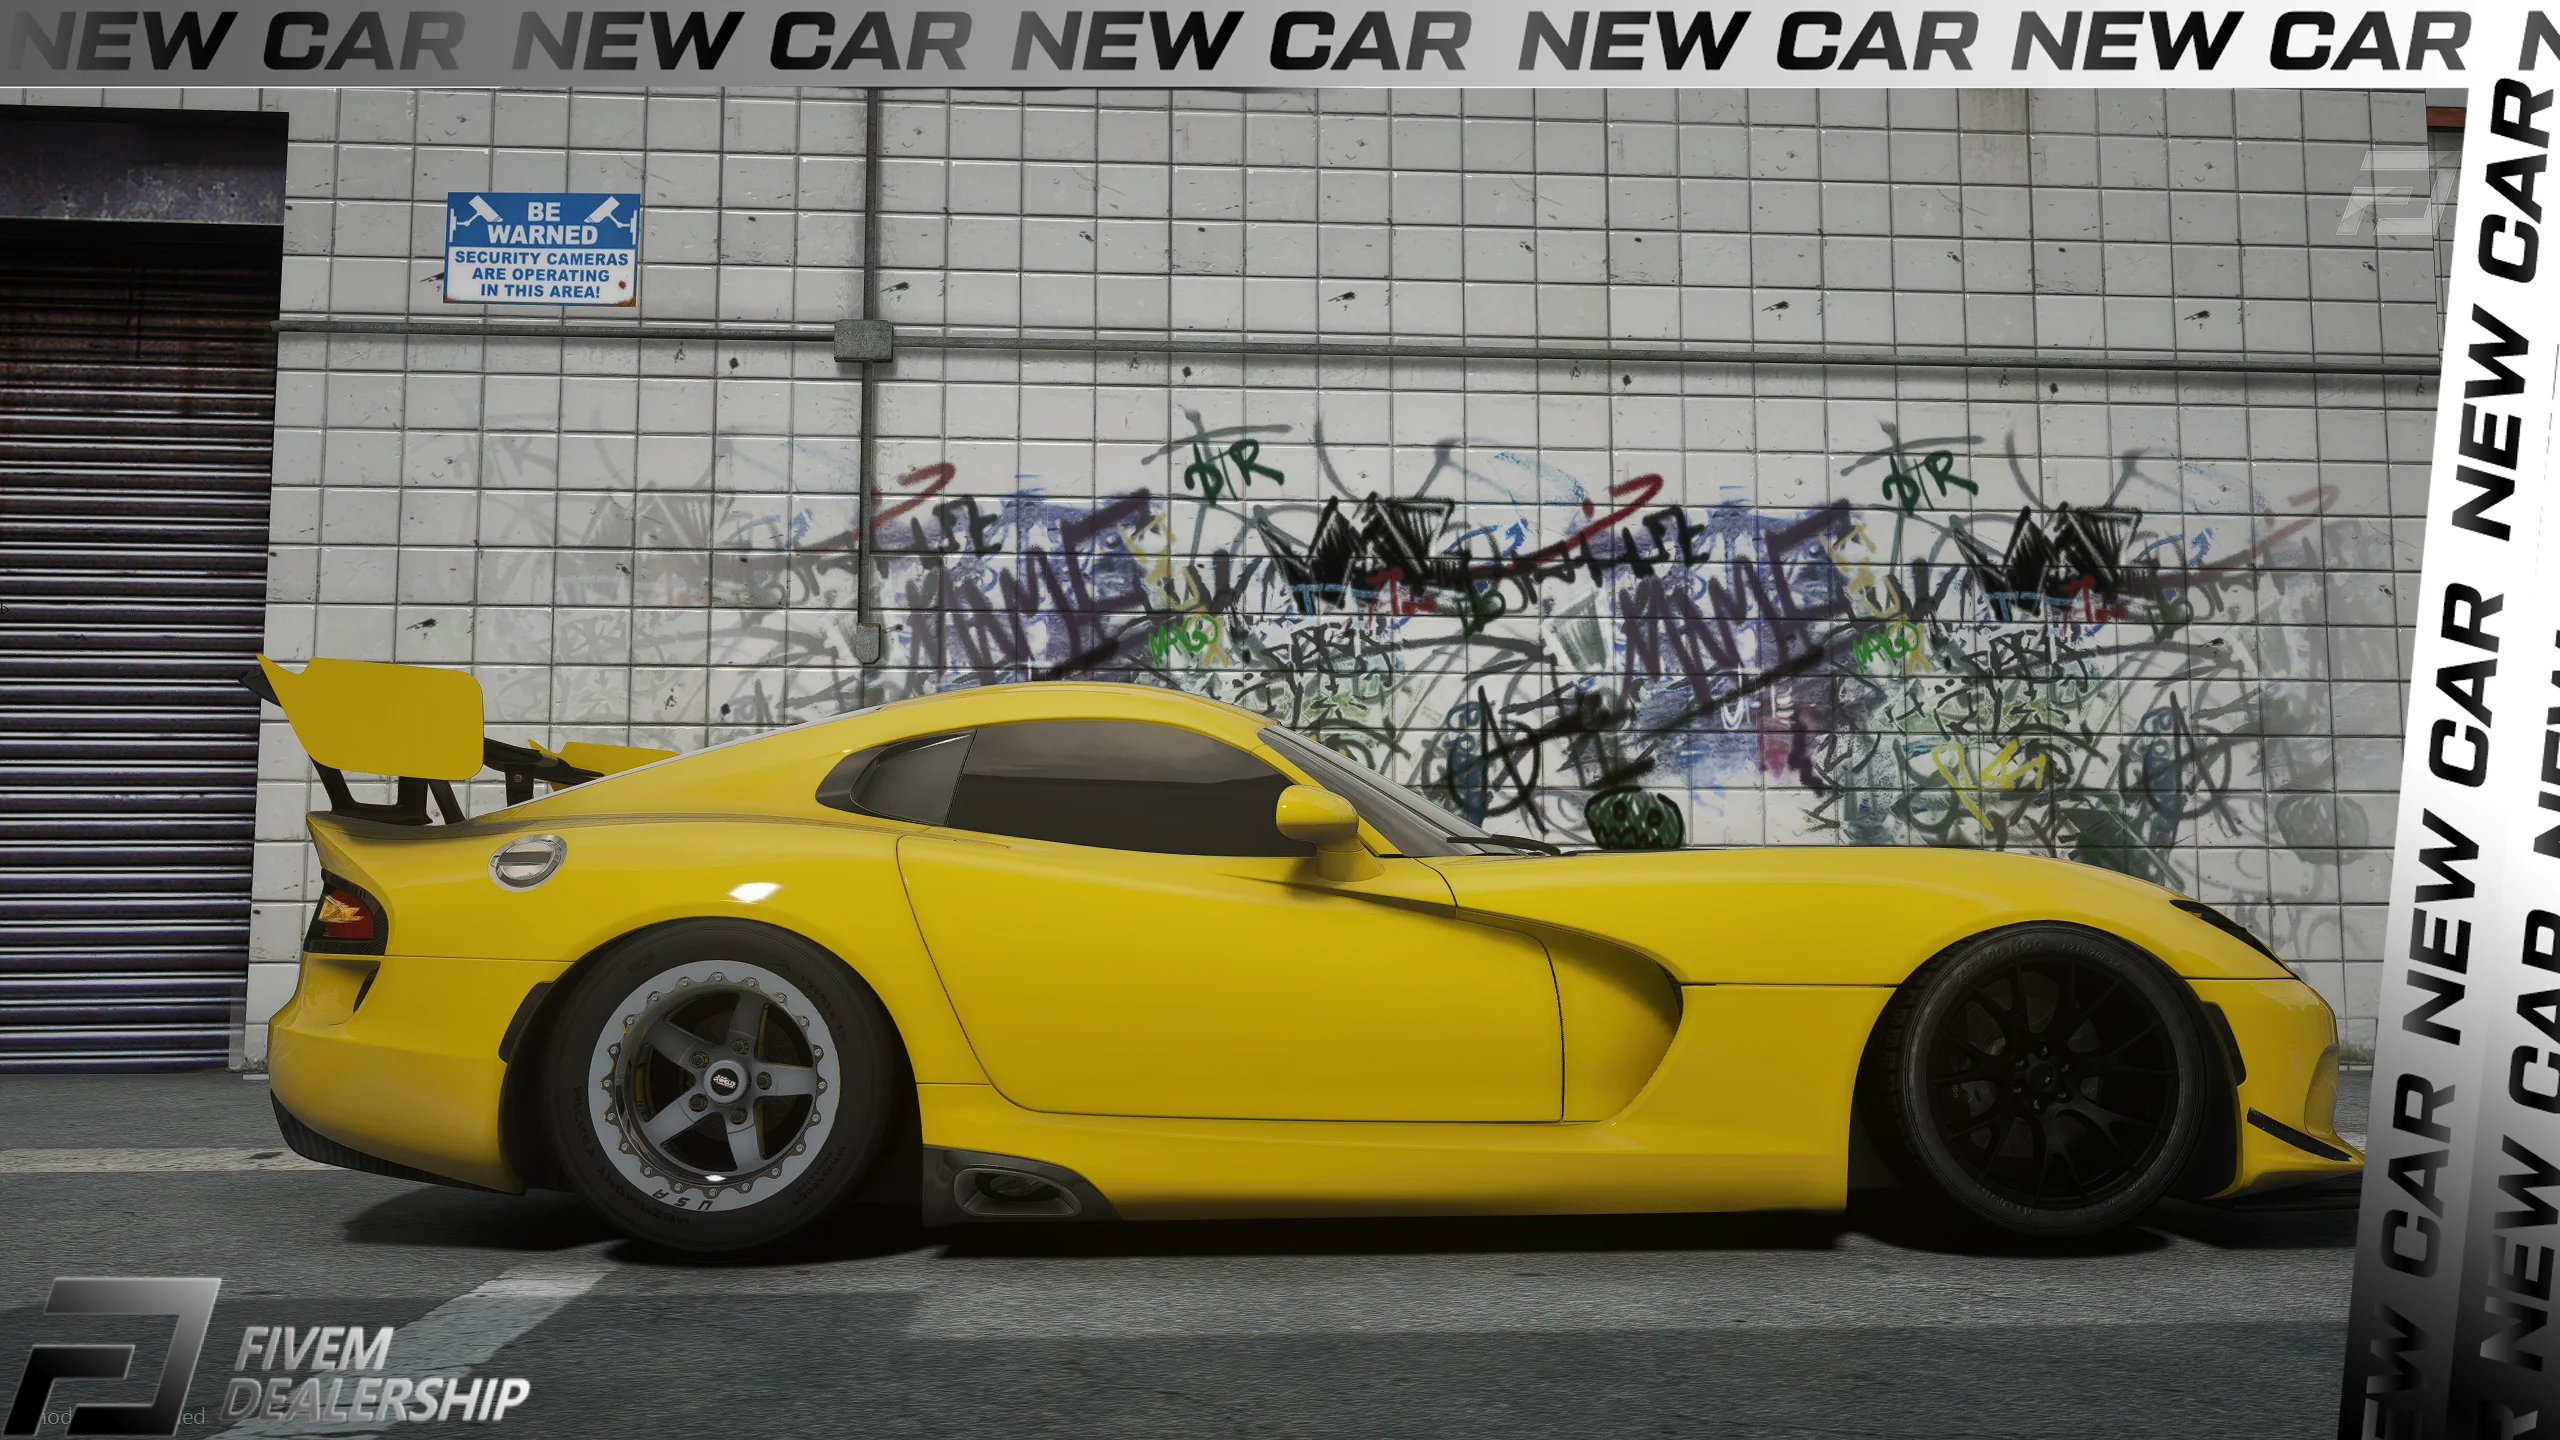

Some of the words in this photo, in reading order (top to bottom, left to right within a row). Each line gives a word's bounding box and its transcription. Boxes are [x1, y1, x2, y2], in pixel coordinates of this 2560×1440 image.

[527, 202, 561, 222] BE
[487, 224, 599, 246] WARNED
[454, 251, 541, 265] SECURITY
[546, 252, 629, 266] CAMERAS
[472, 267, 507, 281] ARE
[512, 268, 610, 283] OPERATING
[480, 284, 498, 297] IN
[504, 284, 544, 298] THIS
[549, 285, 601, 299] AREA!
